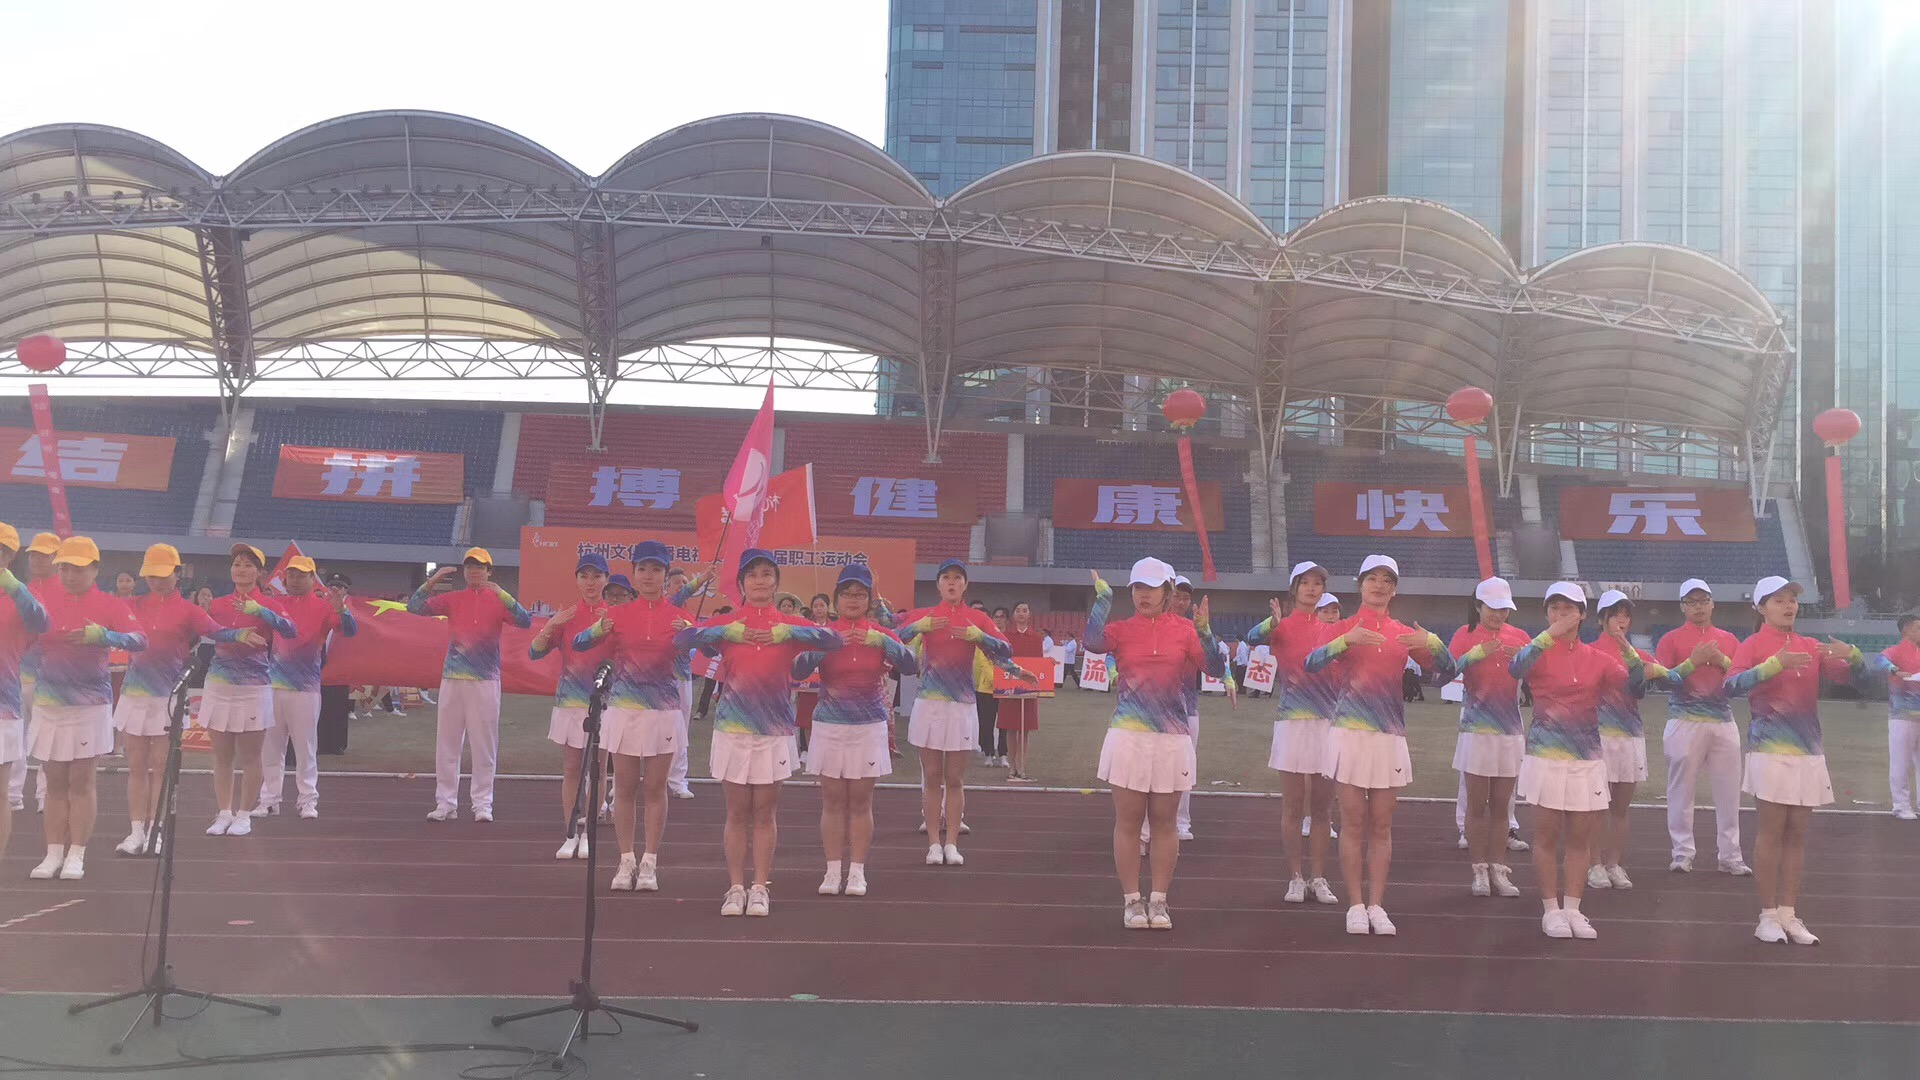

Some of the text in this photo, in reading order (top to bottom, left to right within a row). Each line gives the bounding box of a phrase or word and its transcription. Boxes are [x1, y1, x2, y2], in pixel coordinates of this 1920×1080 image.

[320, 452, 420, 497] 拼
[588, 466, 681, 509] 搏
[850, 476, 939, 518] 健
[1092, 484, 1183, 526] 康
[1356, 489, 1450, 532] 快
[1607, 492, 1707, 536] 乐
[1083, 658, 1107, 683] 流
[1247, 659, 1273, 684] 态
